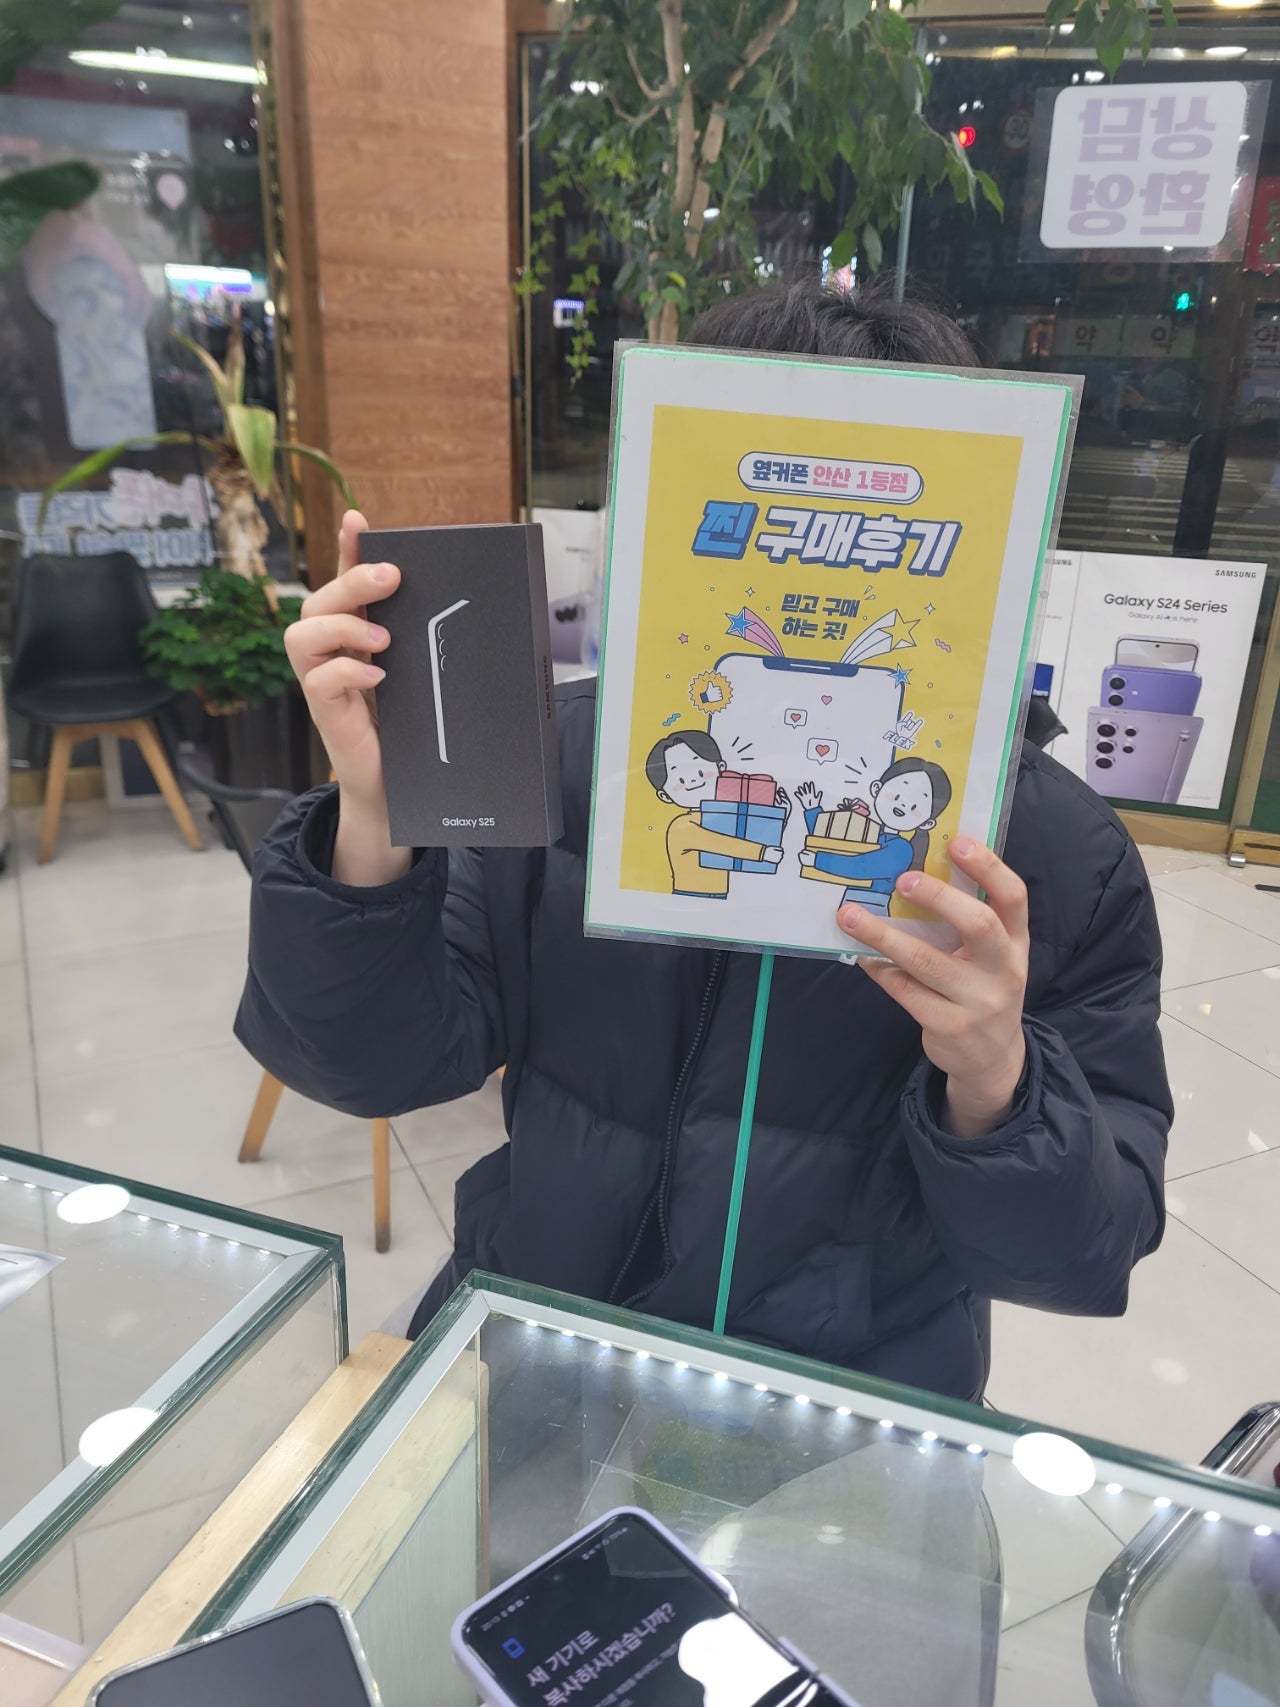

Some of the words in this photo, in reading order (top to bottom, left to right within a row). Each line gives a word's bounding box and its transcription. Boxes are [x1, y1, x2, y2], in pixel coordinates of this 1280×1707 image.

[752, 459, 809, 485] 옆커폰
[812, 464, 851, 489] 안산
[856, 470, 909, 494] 1등점
[691, 500, 760, 560] 찐
[754, 505, 963, 577] 구매후기
[1214, 569, 1257, 579] SAMSUNG
[781, 593, 819, 614] 믿고
[822, 596, 861, 618] 구매
[1103, 593, 1155, 610] Galaxy
[1156, 597, 1181, 610] S24
[1183, 600, 1228, 613] Series
[781, 616, 819, 639] 하는
[822, 620, 848, 640] 곳!
[883, 730, 915, 750] FLEX
[442, 817, 477, 829] Galaxy
[478, 817, 496, 826] S25
[526, 1655, 551, 1688] 새
[545, 1630, 600, 1672] 기기로
[543, 1602, 676, 1707] 복사하시겠습니까?
